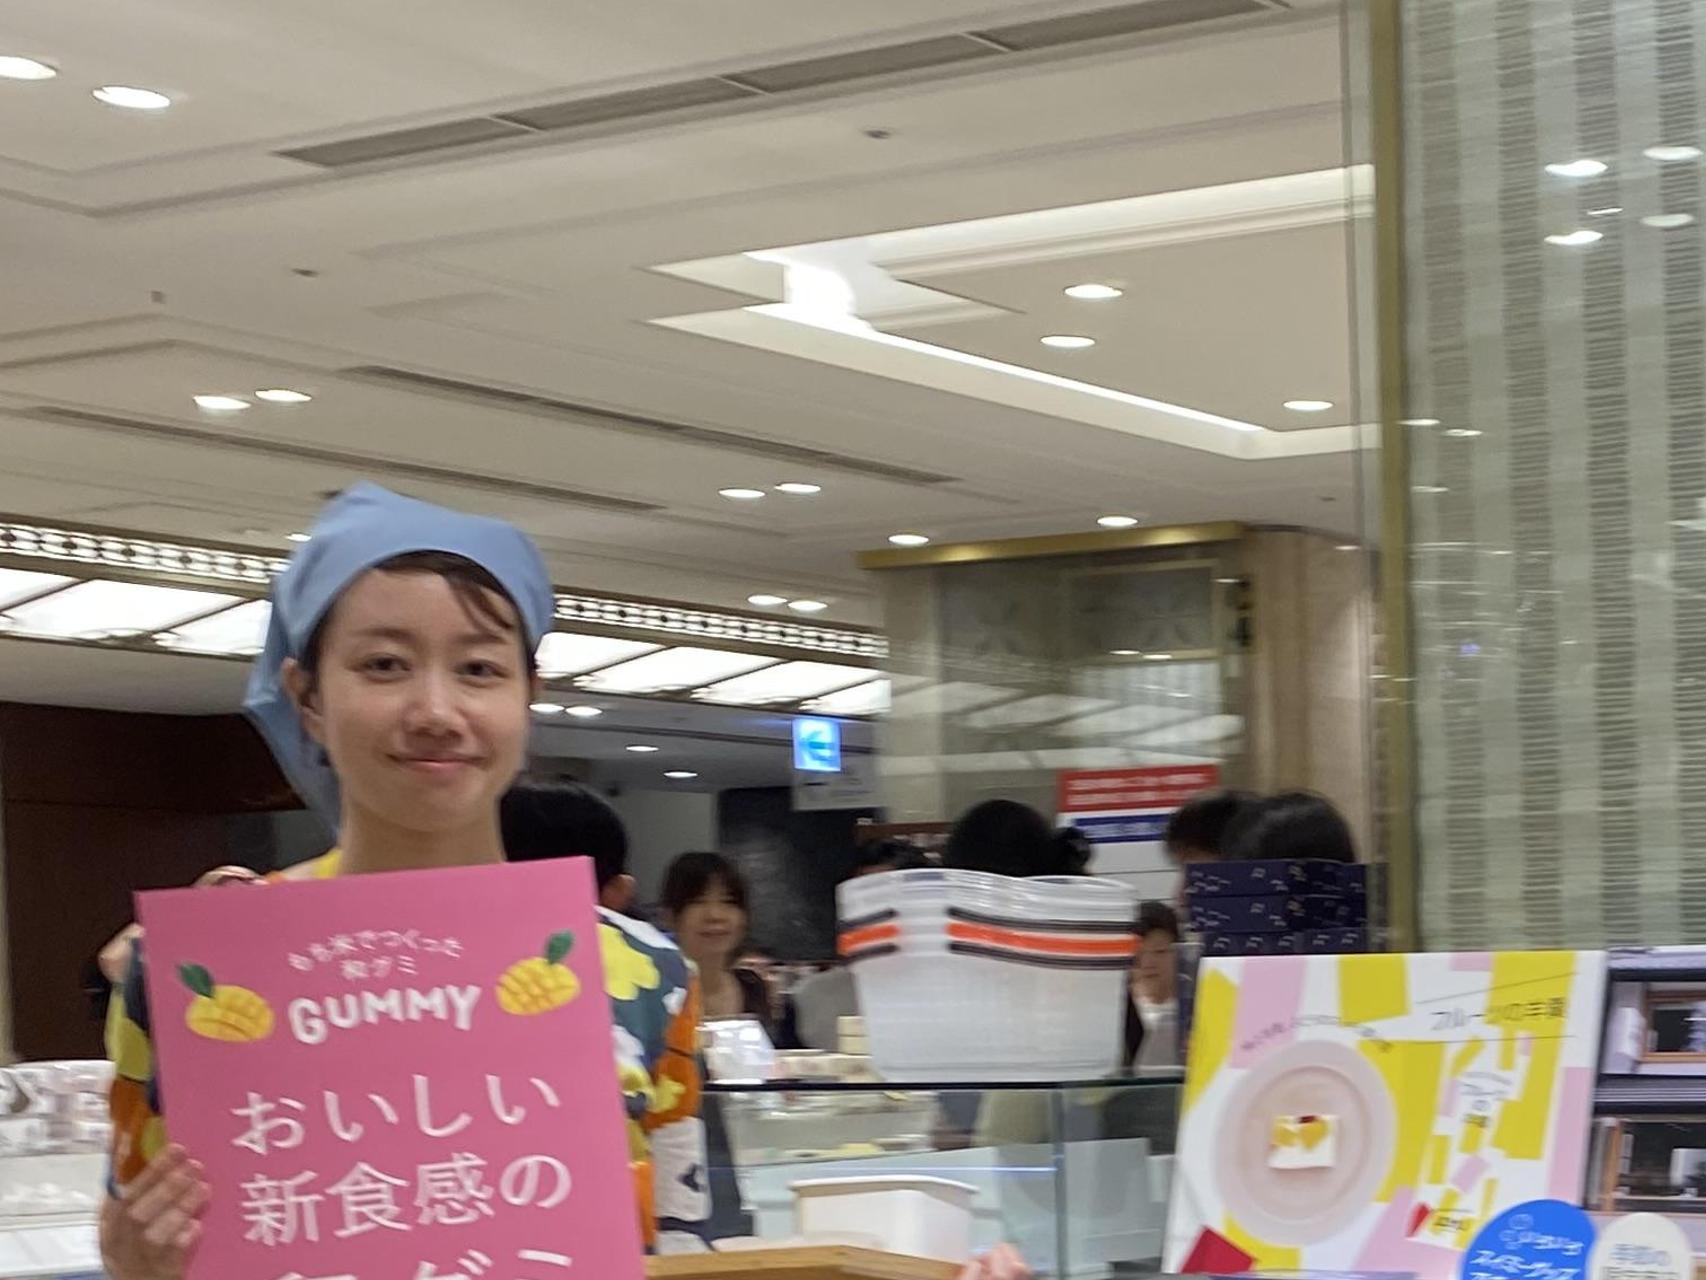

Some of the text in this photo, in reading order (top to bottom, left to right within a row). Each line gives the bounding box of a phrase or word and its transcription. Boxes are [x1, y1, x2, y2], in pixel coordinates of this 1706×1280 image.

[288, 984, 482, 1045] GUMMY
[230, 1074, 560, 1155] おいしい
[240, 1152, 572, 1247] 新食感の
